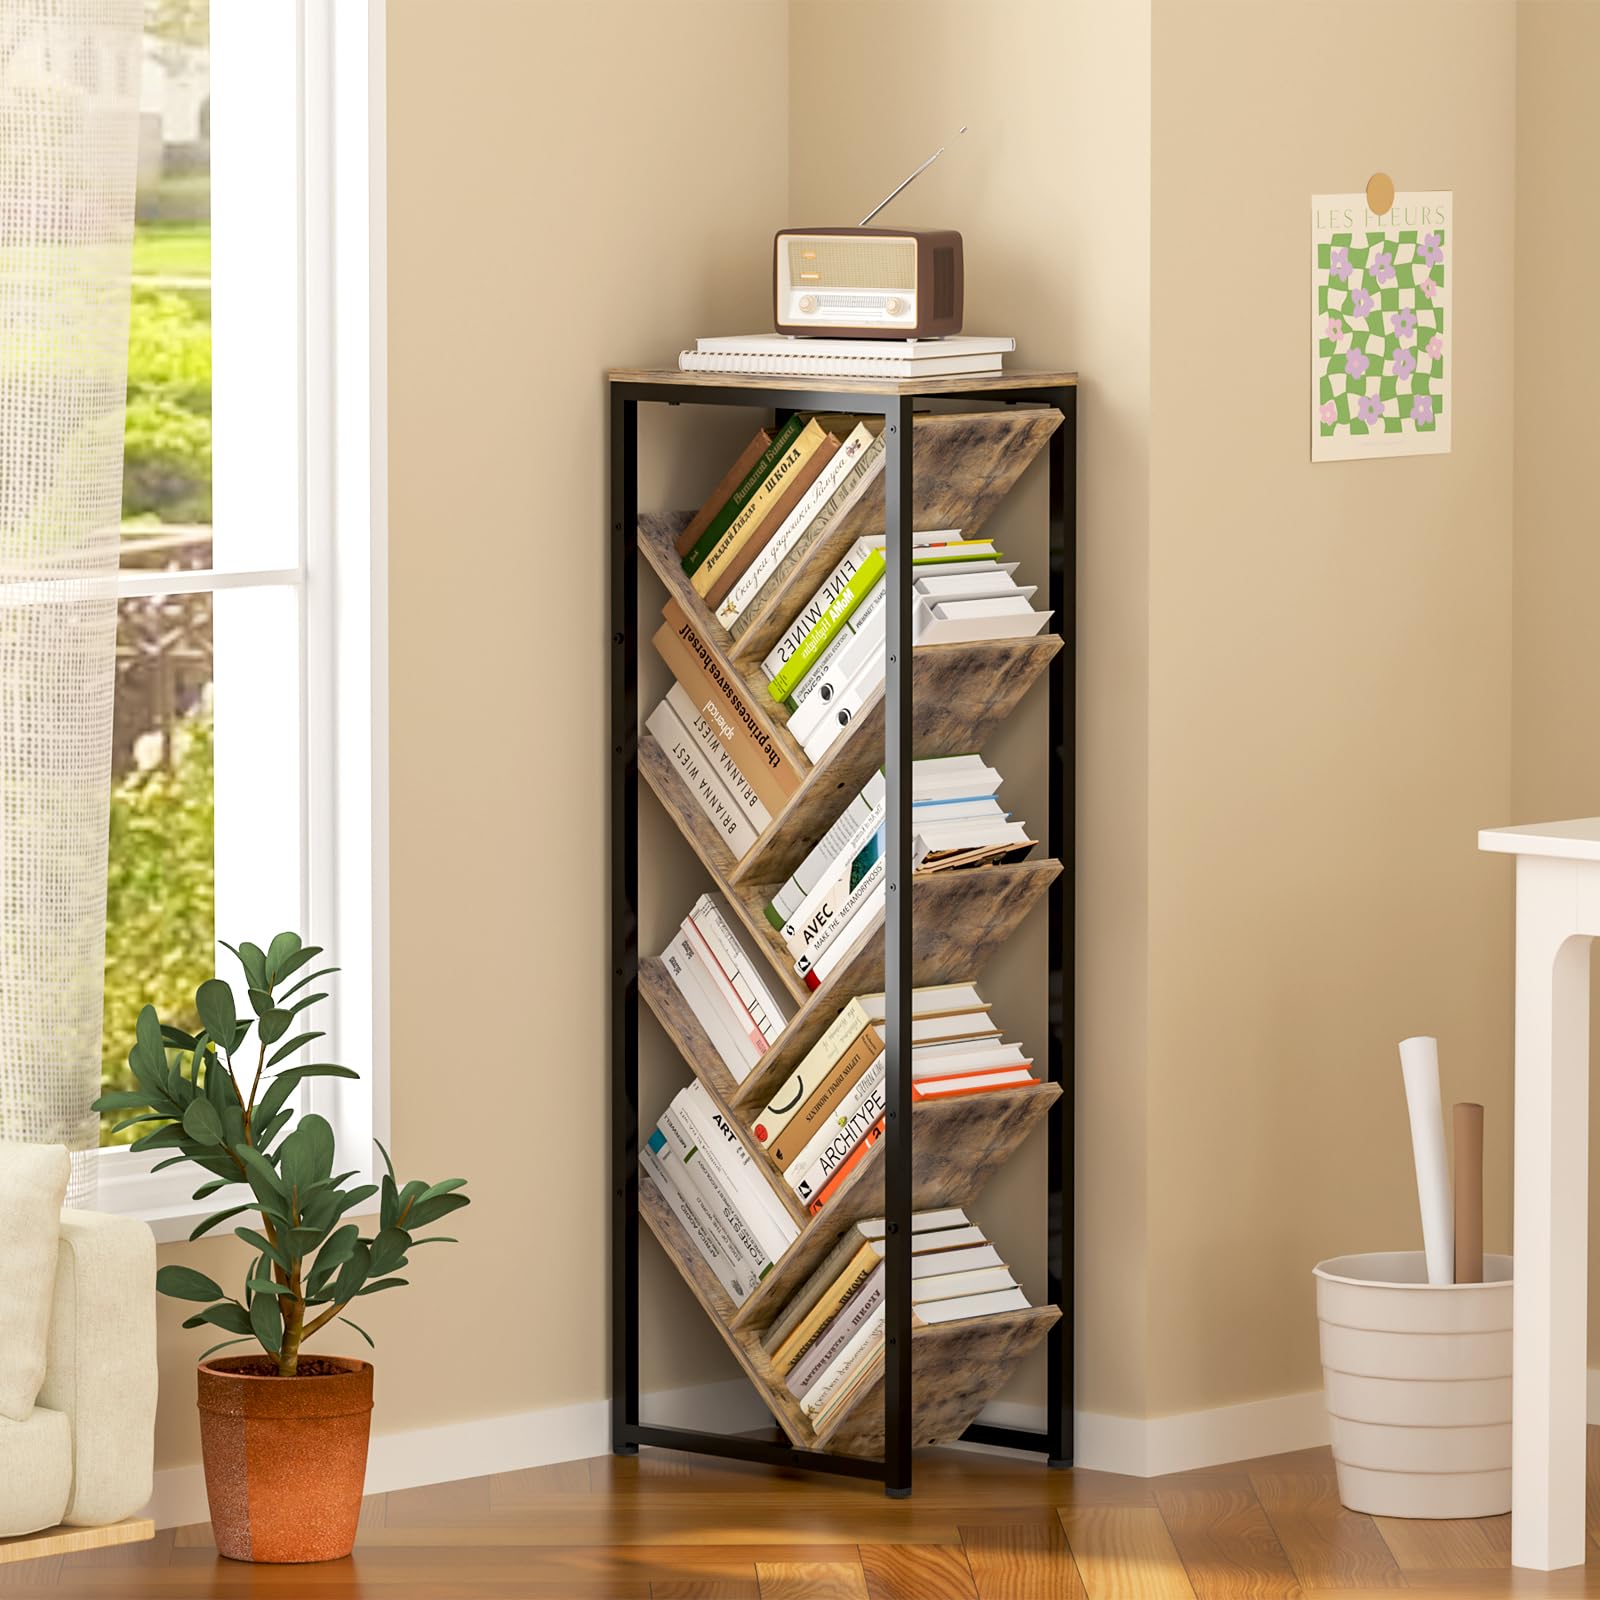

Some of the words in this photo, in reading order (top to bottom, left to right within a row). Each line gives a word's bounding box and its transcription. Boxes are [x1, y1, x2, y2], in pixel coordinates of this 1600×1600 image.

[1316, 208, 1353, 229] LES
[763, 447, 802, 494] ШКОЛА
[676, 623, 712, 668] herself
[707, 662, 734, 698] saves
[692, 713, 721, 753] WIEST
[701, 698, 734, 742] spherical
[727, 693, 770, 747] princess
[671, 740, 700, 780] WIEST
[761, 743, 781, 769] the
[717, 750, 758, 807] BRIANNA
[697, 777, 737, 834] BRIANNA
[803, 902, 834, 945] AVEC
[813, 929, 830, 951] MAKE
[826, 915, 841, 933] THE
[711, 1113, 737, 1142] ART
[818, 1088, 887, 1176] ARCHITYPE
[679, 1203, 698, 1230] ADDIO
[721, 1206, 763, 1266] FORESTS
[696, 1228, 717, 1258] AFRICA
